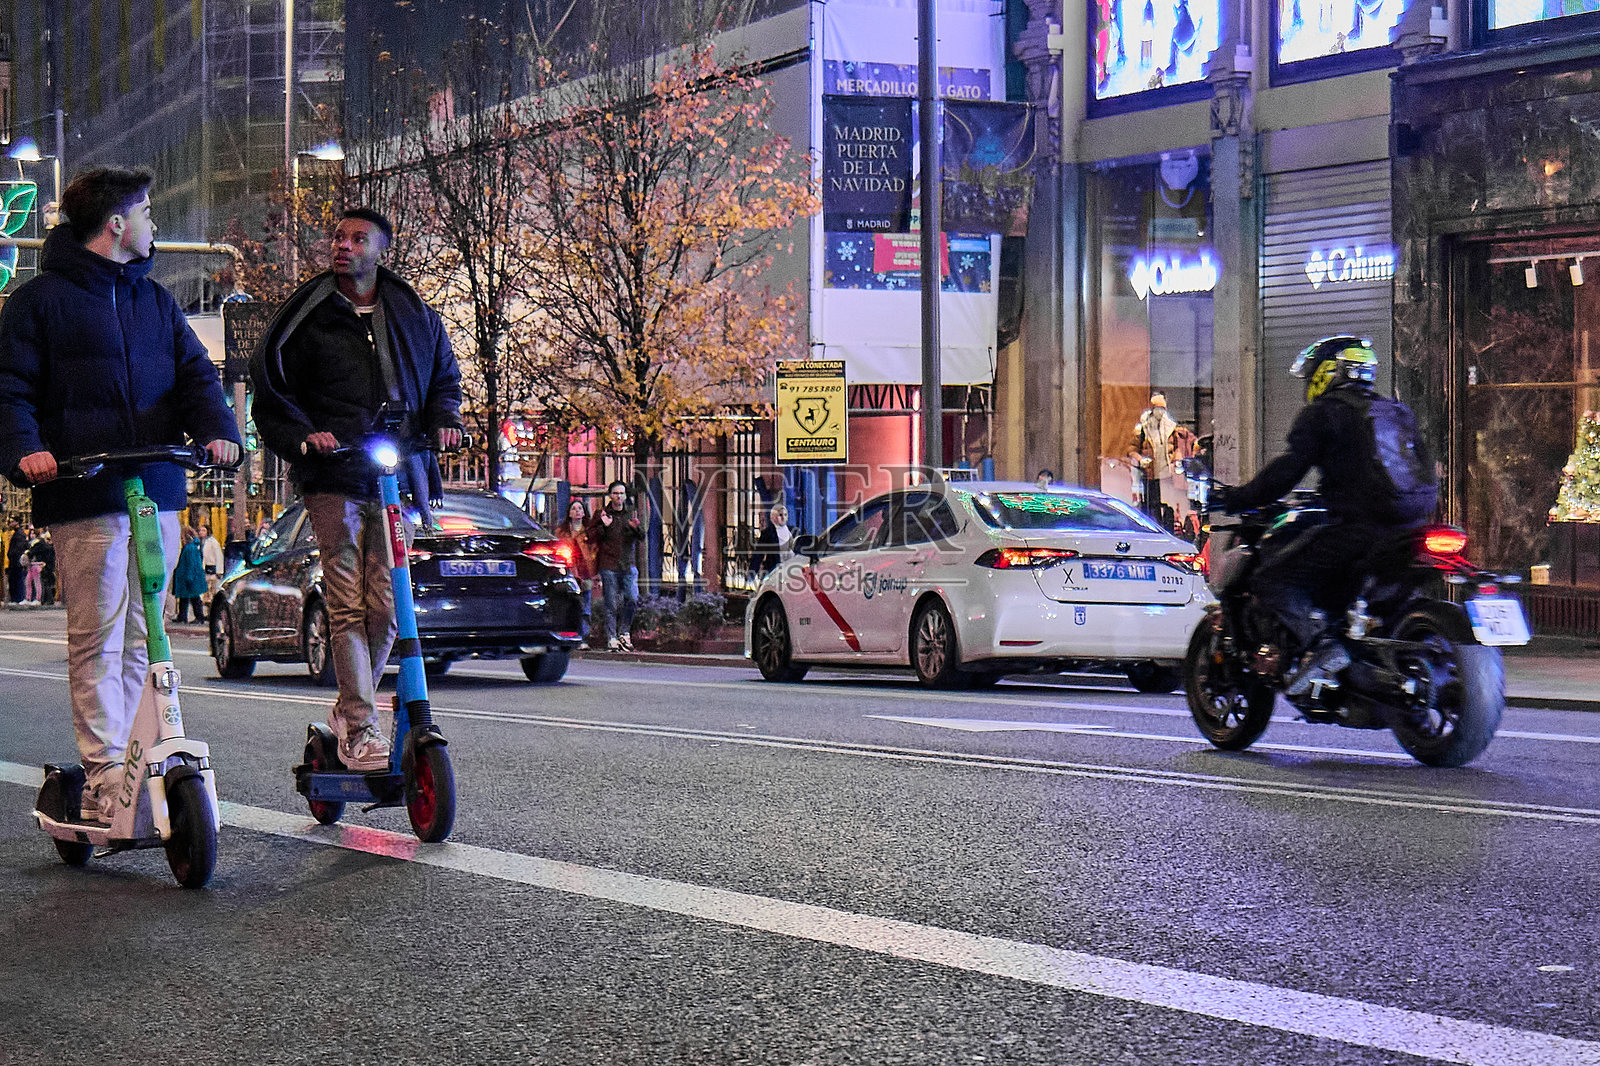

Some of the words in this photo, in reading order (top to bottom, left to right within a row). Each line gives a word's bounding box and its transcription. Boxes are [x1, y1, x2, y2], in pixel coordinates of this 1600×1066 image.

[836, 79, 918, 97] MERCADILLO
[947, 84, 981, 99] GATO
[835, 126, 905, 143] MADRID,
[838, 144, 898, 158] PUERTA
[843, 160, 864, 175] DE
[869, 161, 890, 175] LA
[831, 177, 905, 192] NAVIDAD
[857, 219, 891, 229] MADRID
[1327, 248, 1395, 283] Colum
[788, 438, 836, 447] CENTAURO
[450, 562, 484, 575] 5076
[1091, 564, 1126, 579] 3376
[1127, 565, 1154, 581] MMF
[878, 573, 908, 594] joinup
